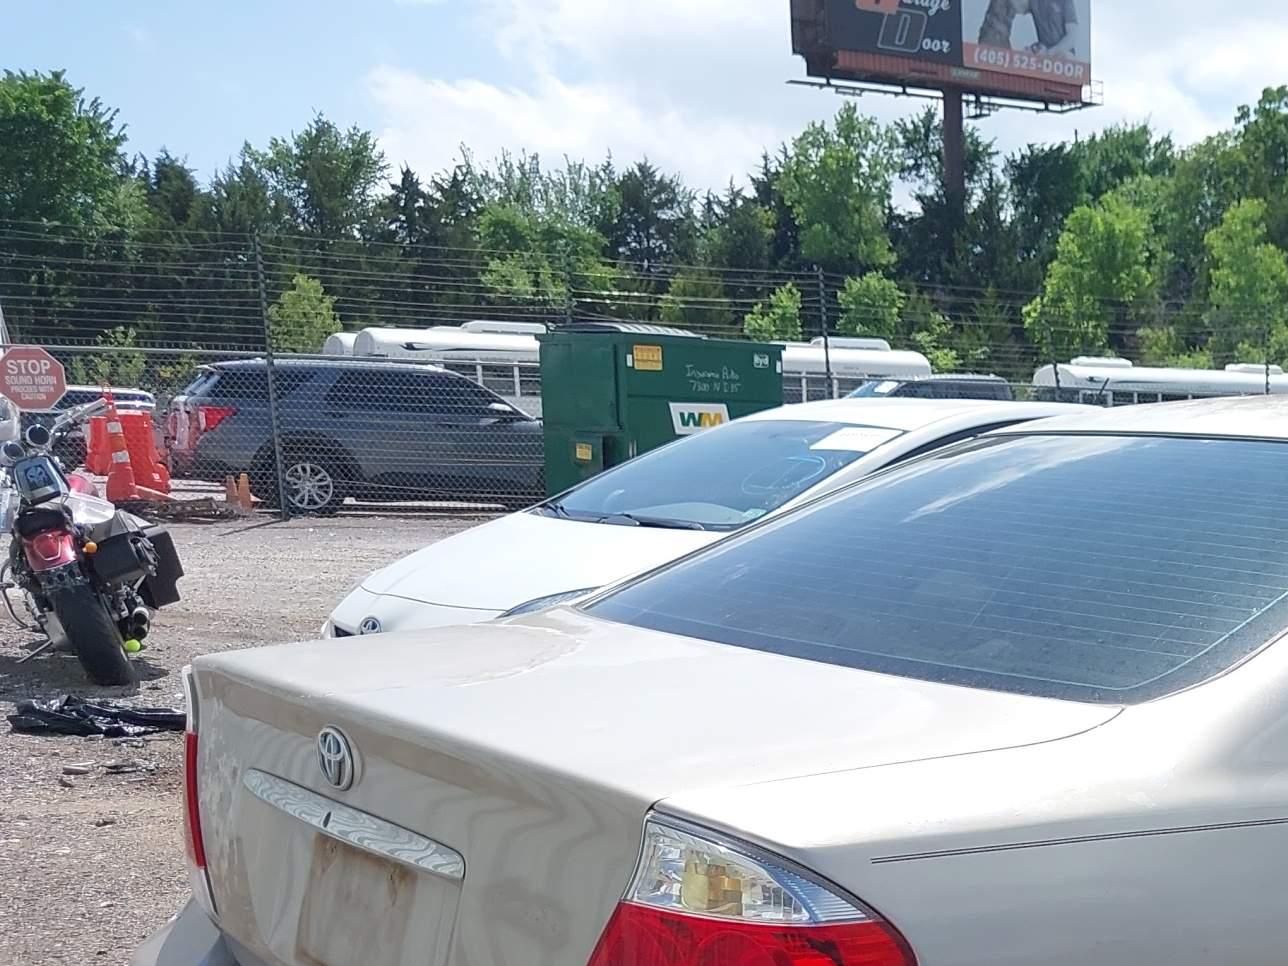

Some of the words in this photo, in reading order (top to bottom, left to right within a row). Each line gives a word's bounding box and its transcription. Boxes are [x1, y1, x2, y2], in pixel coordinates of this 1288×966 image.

[974, 47, 1010, 68] (405)
[1013, 53, 1084, 78] 525-DOOR
[6, 360, 51, 374] STOP
[5, 376, 33, 385] SOUND
[35, 376, 57, 385] HORN
[679, 411, 723, 428] WM
